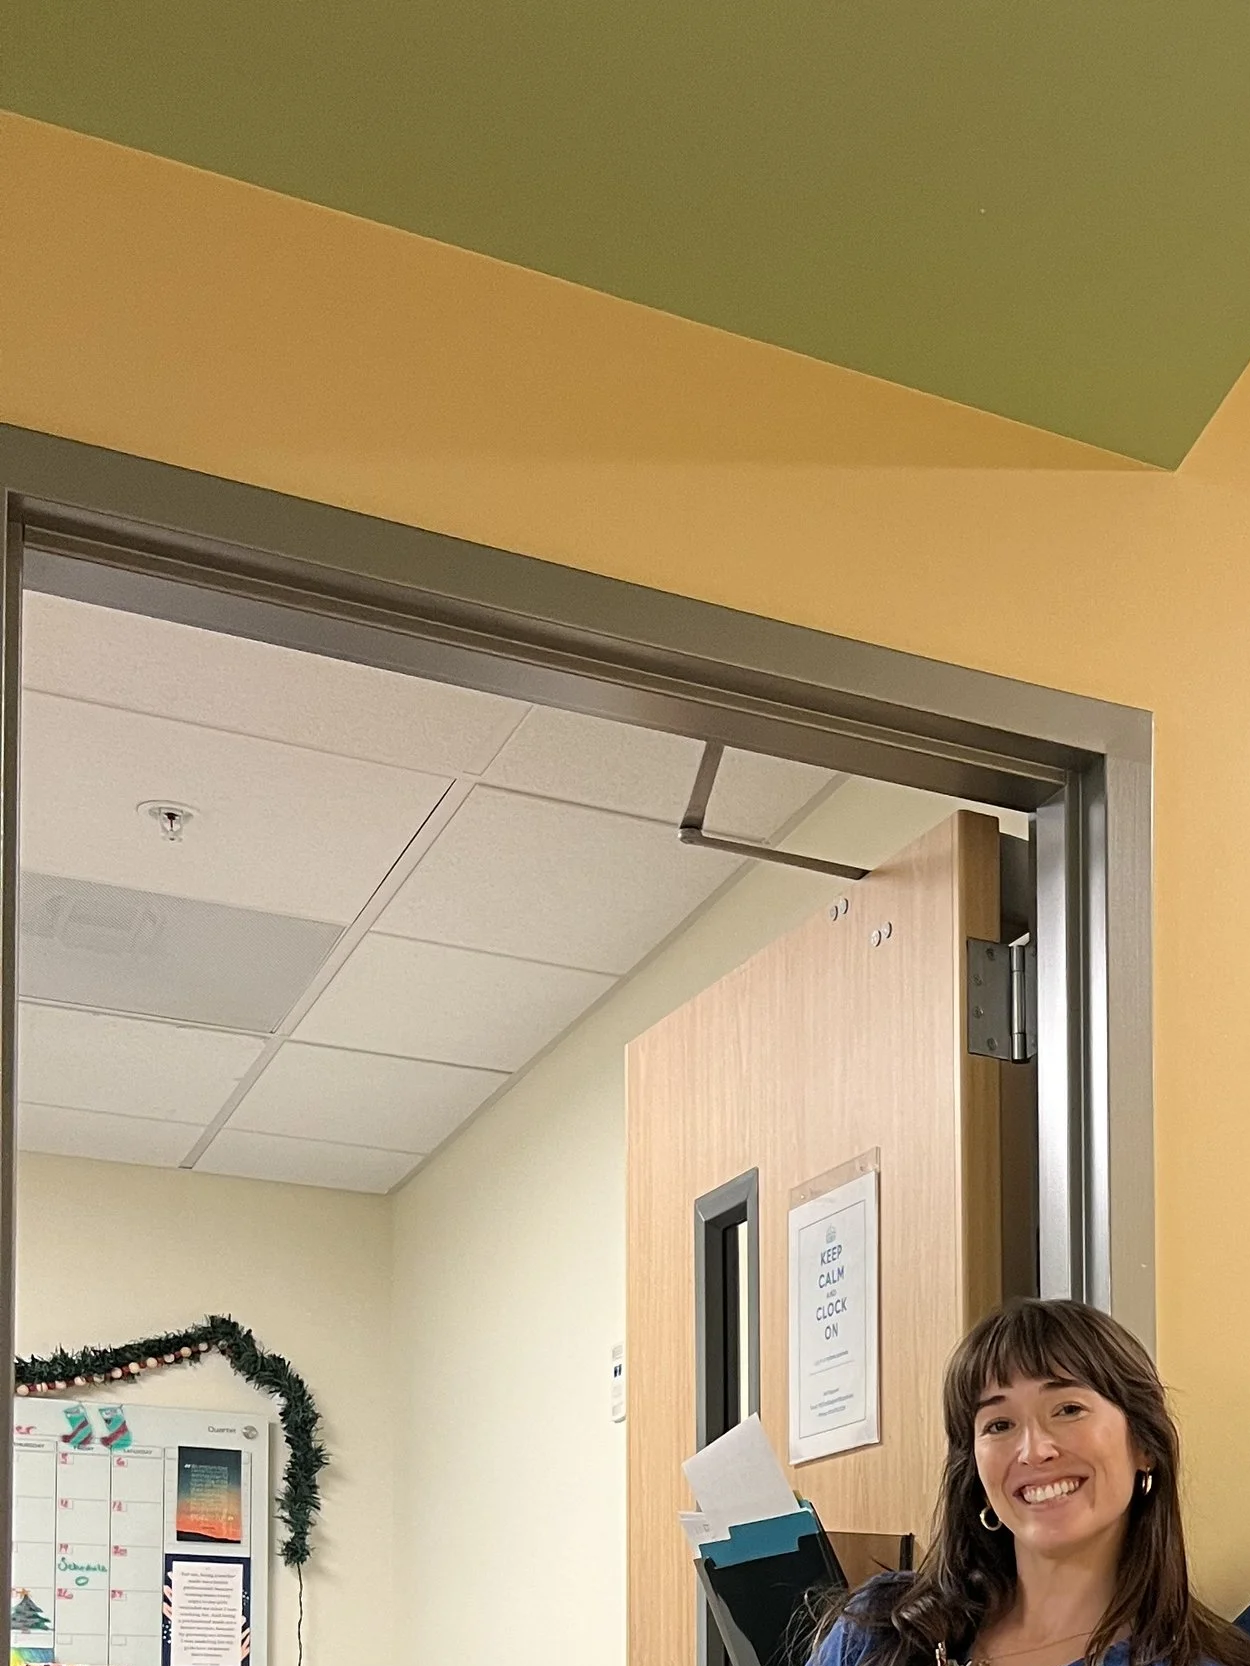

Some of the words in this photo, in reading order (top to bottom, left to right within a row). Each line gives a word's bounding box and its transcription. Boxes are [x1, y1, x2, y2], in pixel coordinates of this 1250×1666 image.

[820, 1245, 843, 1266] KEEP
[818, 1266, 845, 1289] CALM
[826, 1289, 837, 1299] AND
[816, 1297, 847, 1321] CLOCK
[824, 1323, 838, 1340] ON
